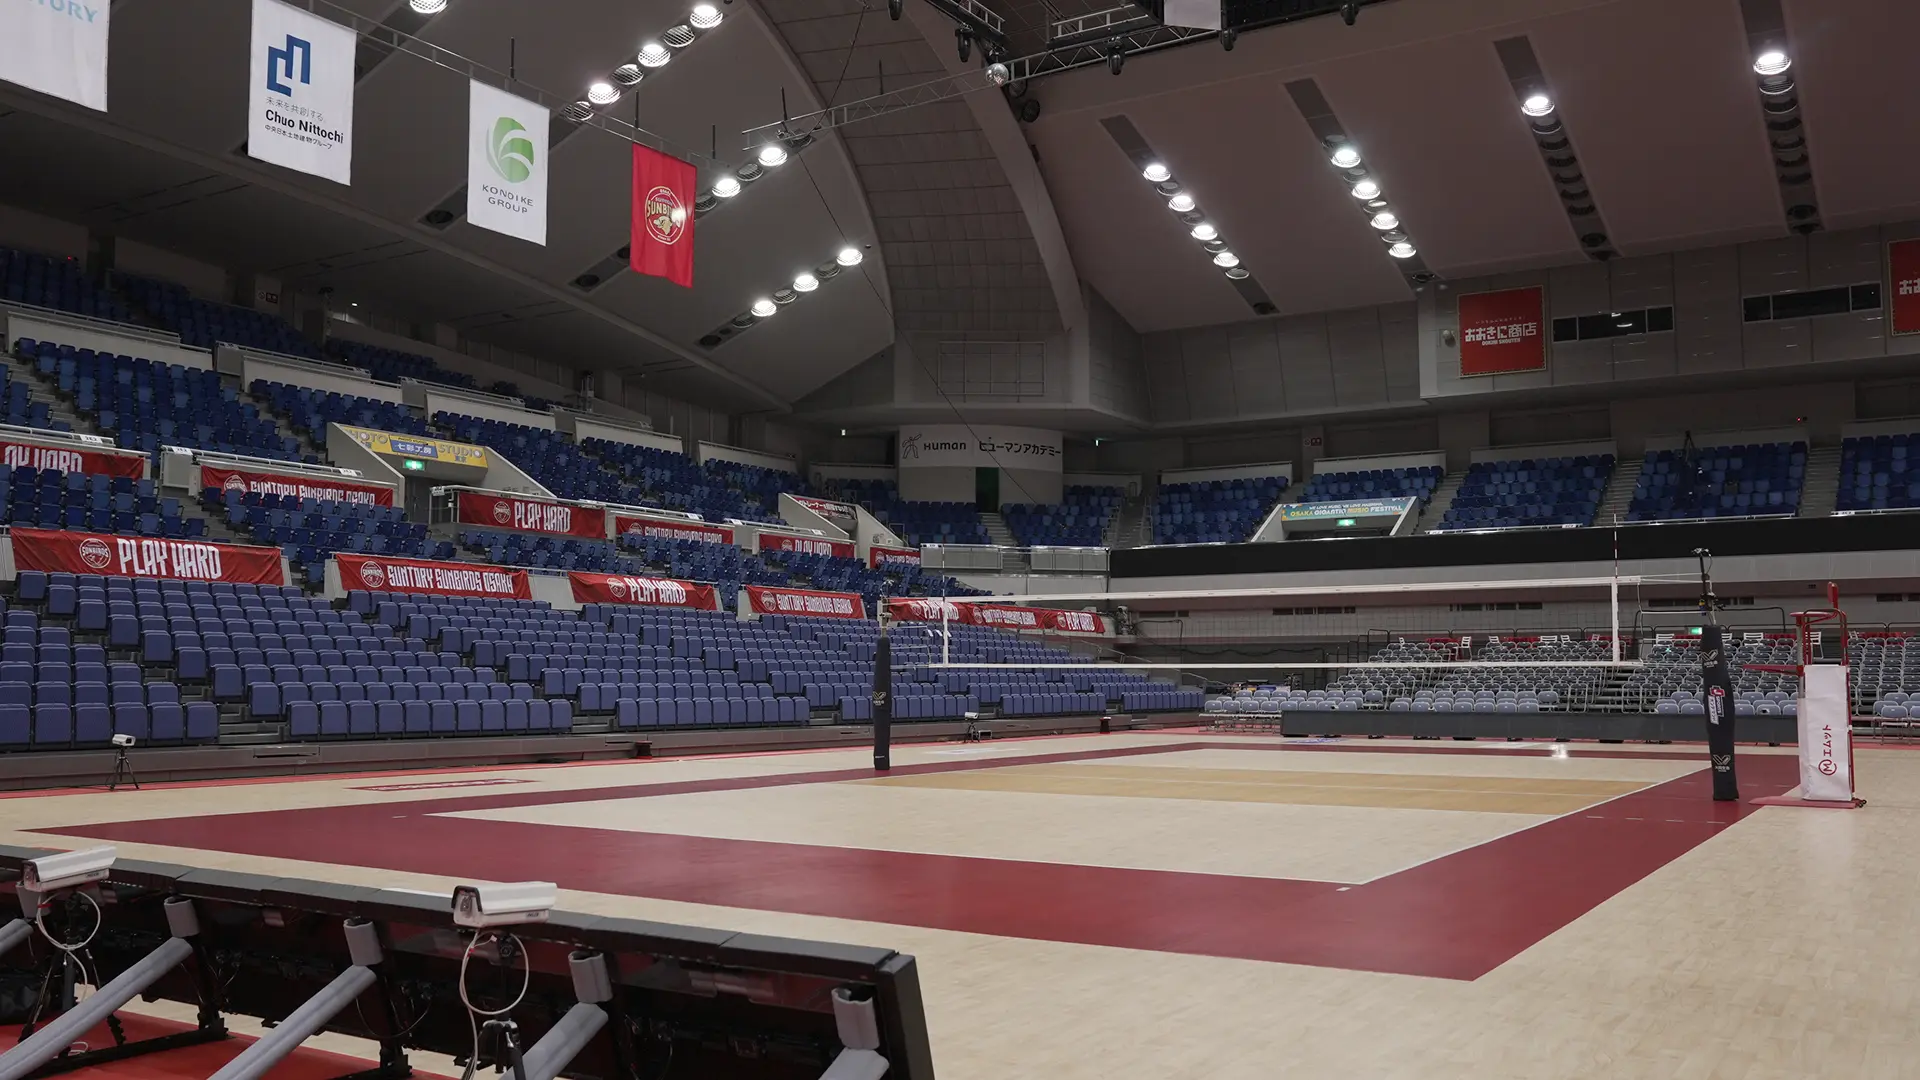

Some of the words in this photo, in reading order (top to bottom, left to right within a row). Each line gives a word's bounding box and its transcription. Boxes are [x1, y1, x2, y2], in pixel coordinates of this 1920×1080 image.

[264, 124, 333, 150] 中央日本土地建物グループ
[265, 109, 295, 128] Chuo
[298, 119, 344, 144] Nittochi
[488, 196, 528, 214] GROUP
[1465, 322, 1537, 342] おおきに商店
[440, 443, 483, 459] STUDIO
[923, 441, 967, 451] Human
[979, 440, 1061, 457] ヒューマンアカデミー
[515, 501, 541, 530] PLAY
[543, 505, 571, 533] HARD
[117, 538, 168, 576] PLAY
[170, 542, 221, 579] HARD
[387, 565, 433, 588] SUNTORY
[435, 568, 482, 591] SUNBIRDS
[483, 572, 514, 594] OSAKA
[624, 577, 656, 602] PLAY
[655, 580, 686, 604] HARD
[1822, 724, 1832, 757] エムット
